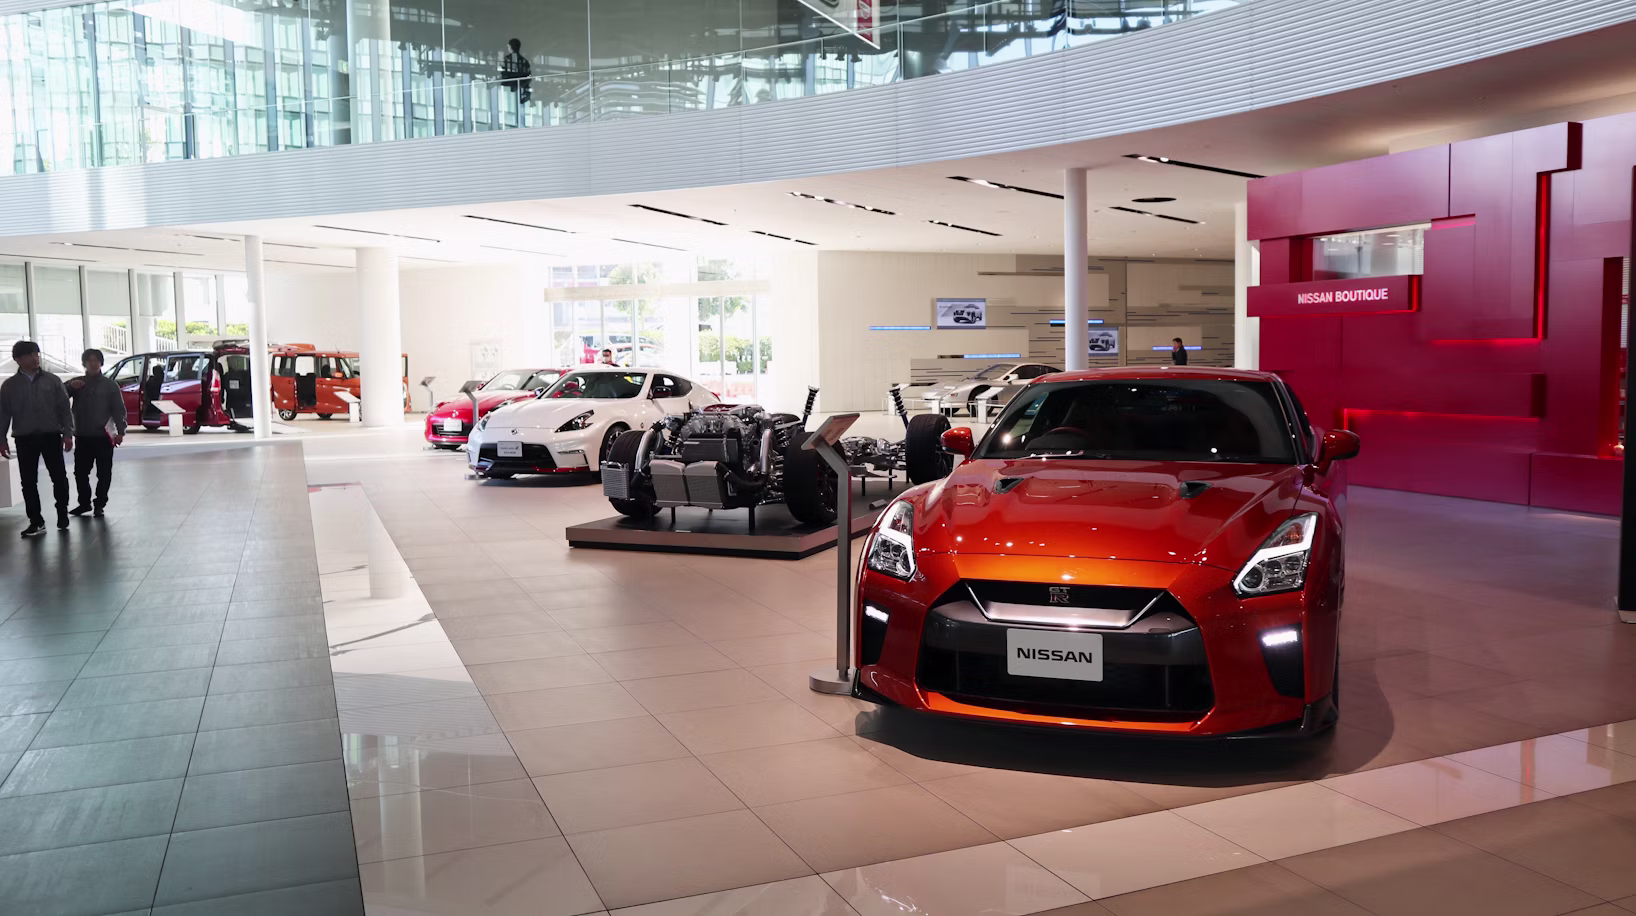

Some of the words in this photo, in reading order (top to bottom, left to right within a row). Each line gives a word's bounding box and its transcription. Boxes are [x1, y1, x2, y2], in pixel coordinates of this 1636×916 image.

[1297, 291, 1333, 304] NISSAN
[1335, 288, 1389, 302] BOUTIQUE
[1017, 647, 1093, 664] NISSAN
